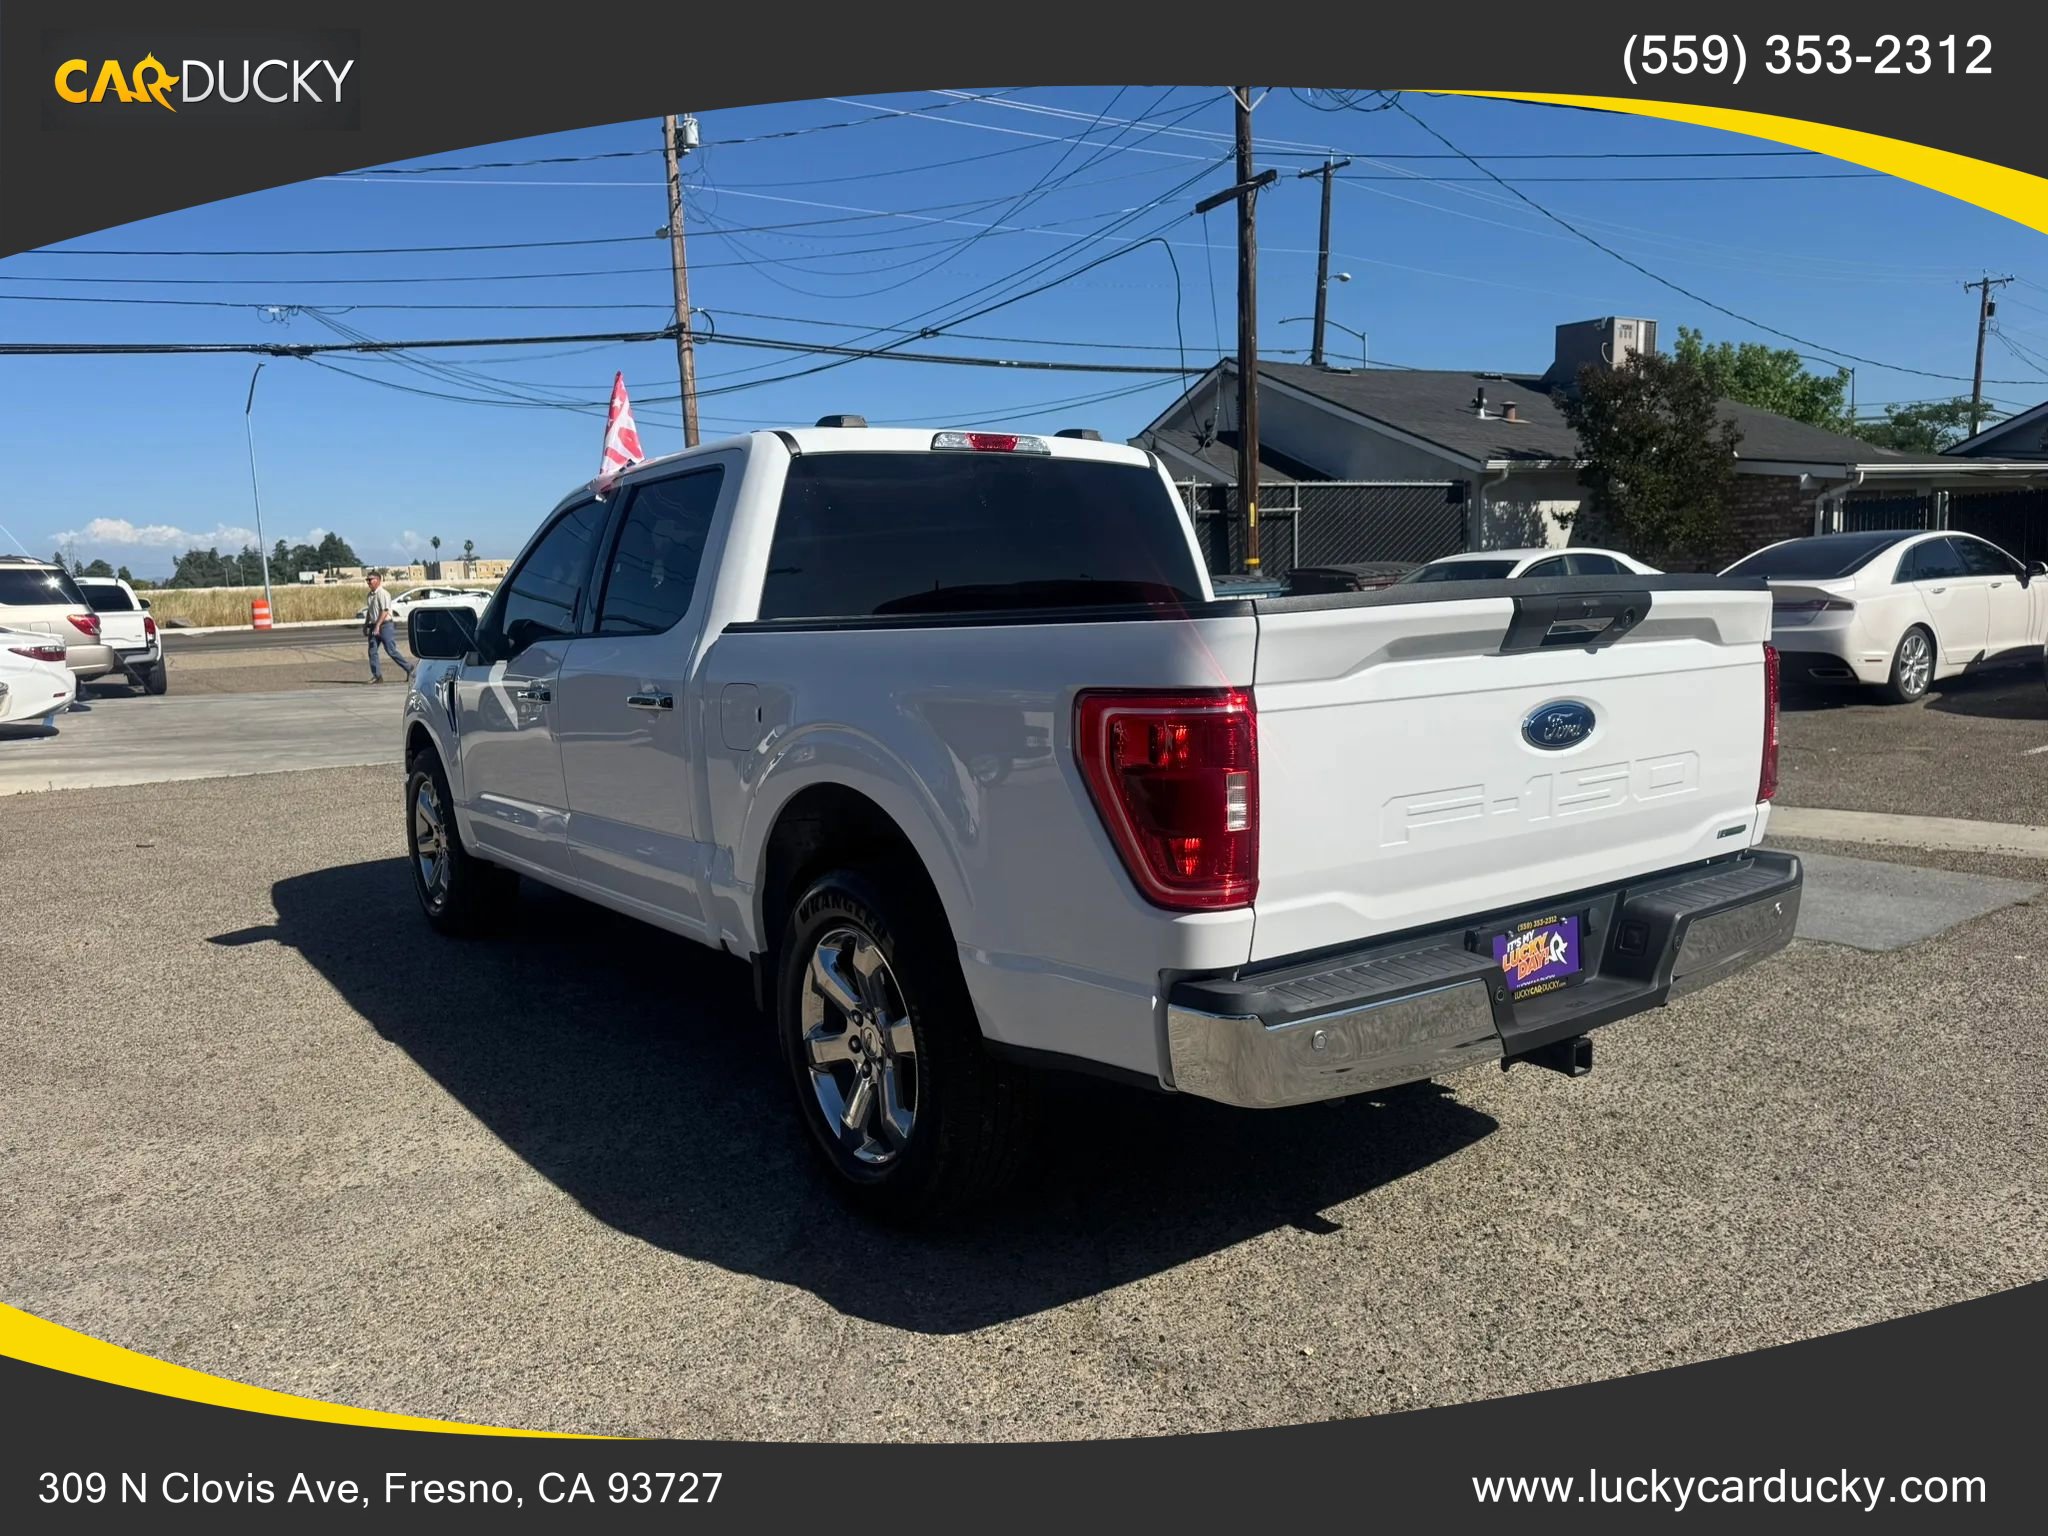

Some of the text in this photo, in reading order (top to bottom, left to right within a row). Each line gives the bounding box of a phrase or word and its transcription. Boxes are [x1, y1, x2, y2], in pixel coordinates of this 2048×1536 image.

[1543, 711, 1584, 741] Ford
[1379, 750, 1700, 848] F-150
[1502, 931, 1549, 973] LUCKY
[1507, 930, 1535, 952] IT'S MY
[1517, 947, 1549, 980] DAY!
